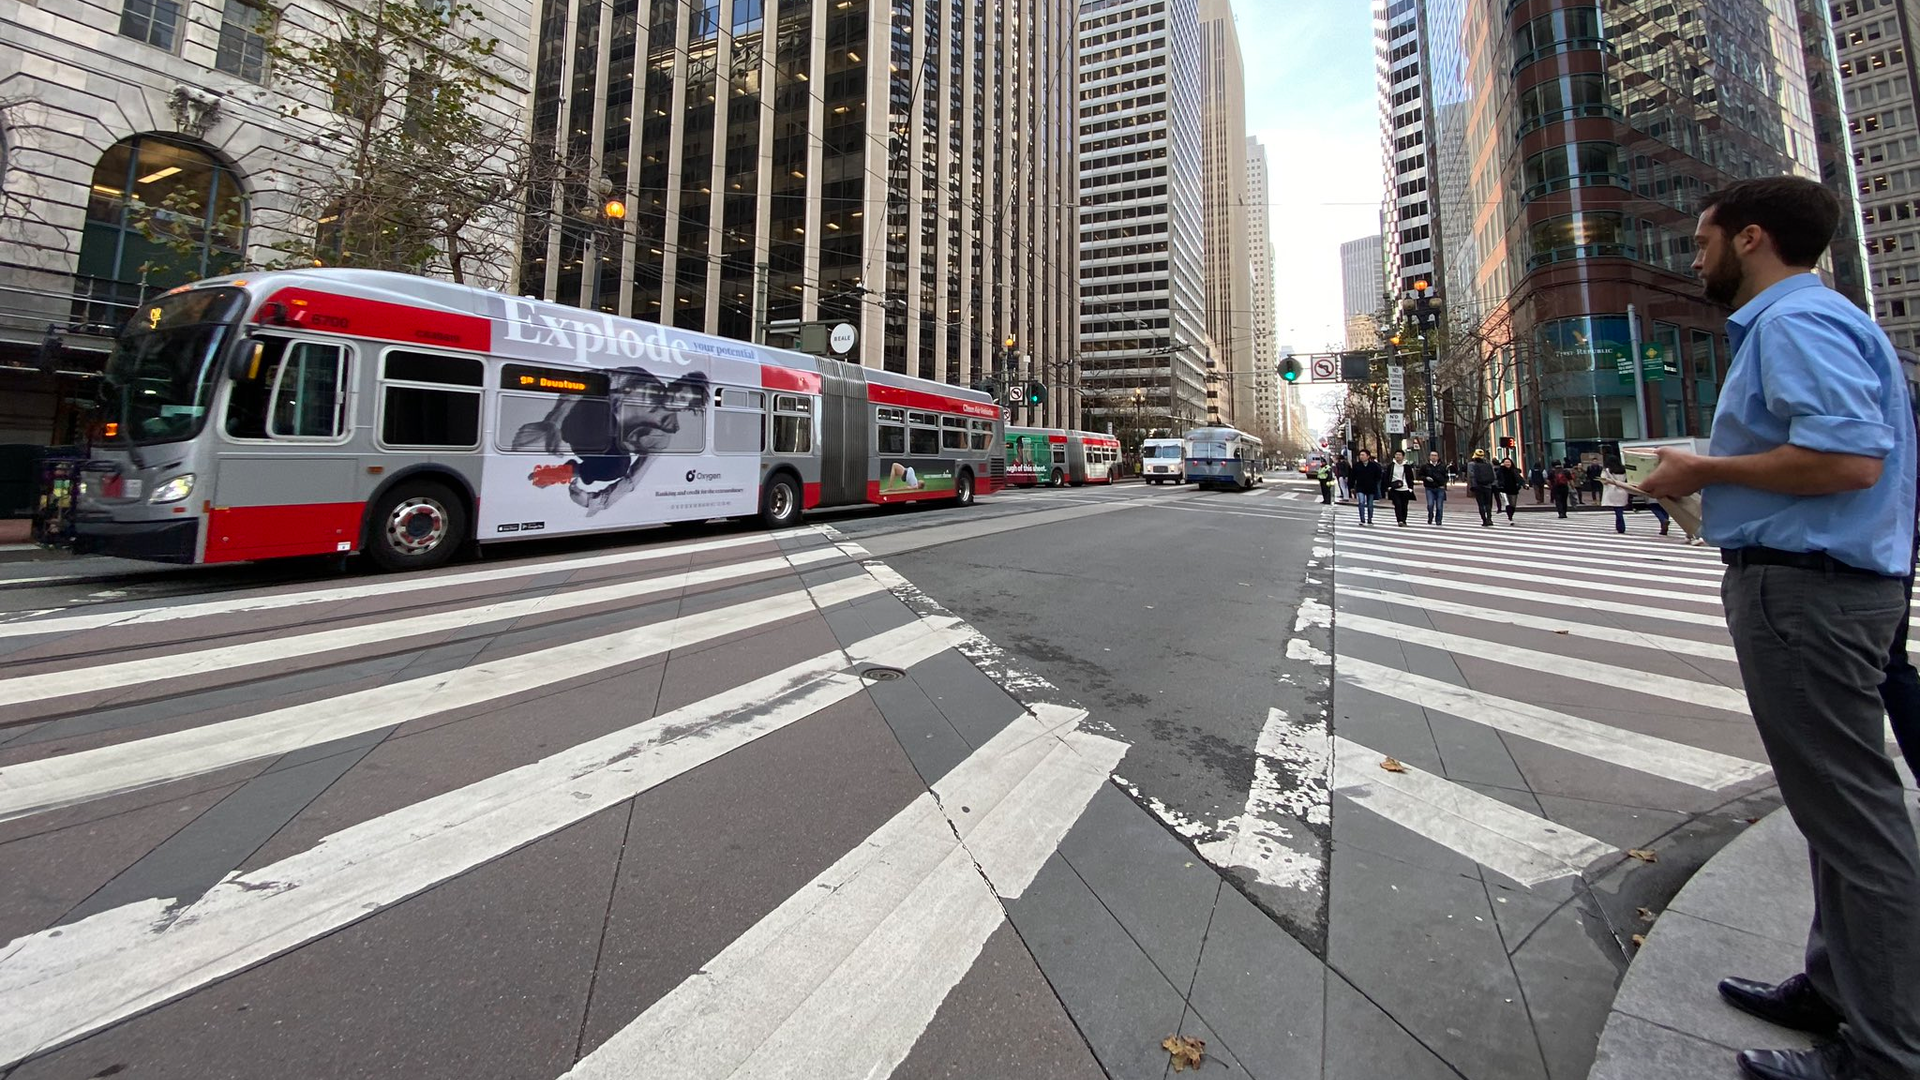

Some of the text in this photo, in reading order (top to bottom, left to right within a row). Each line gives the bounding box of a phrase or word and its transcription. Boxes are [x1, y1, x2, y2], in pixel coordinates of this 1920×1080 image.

[502, 297, 692, 366] Explode
[693, 342, 755, 359] your potential
[697, 472, 721, 481] Oxygen
